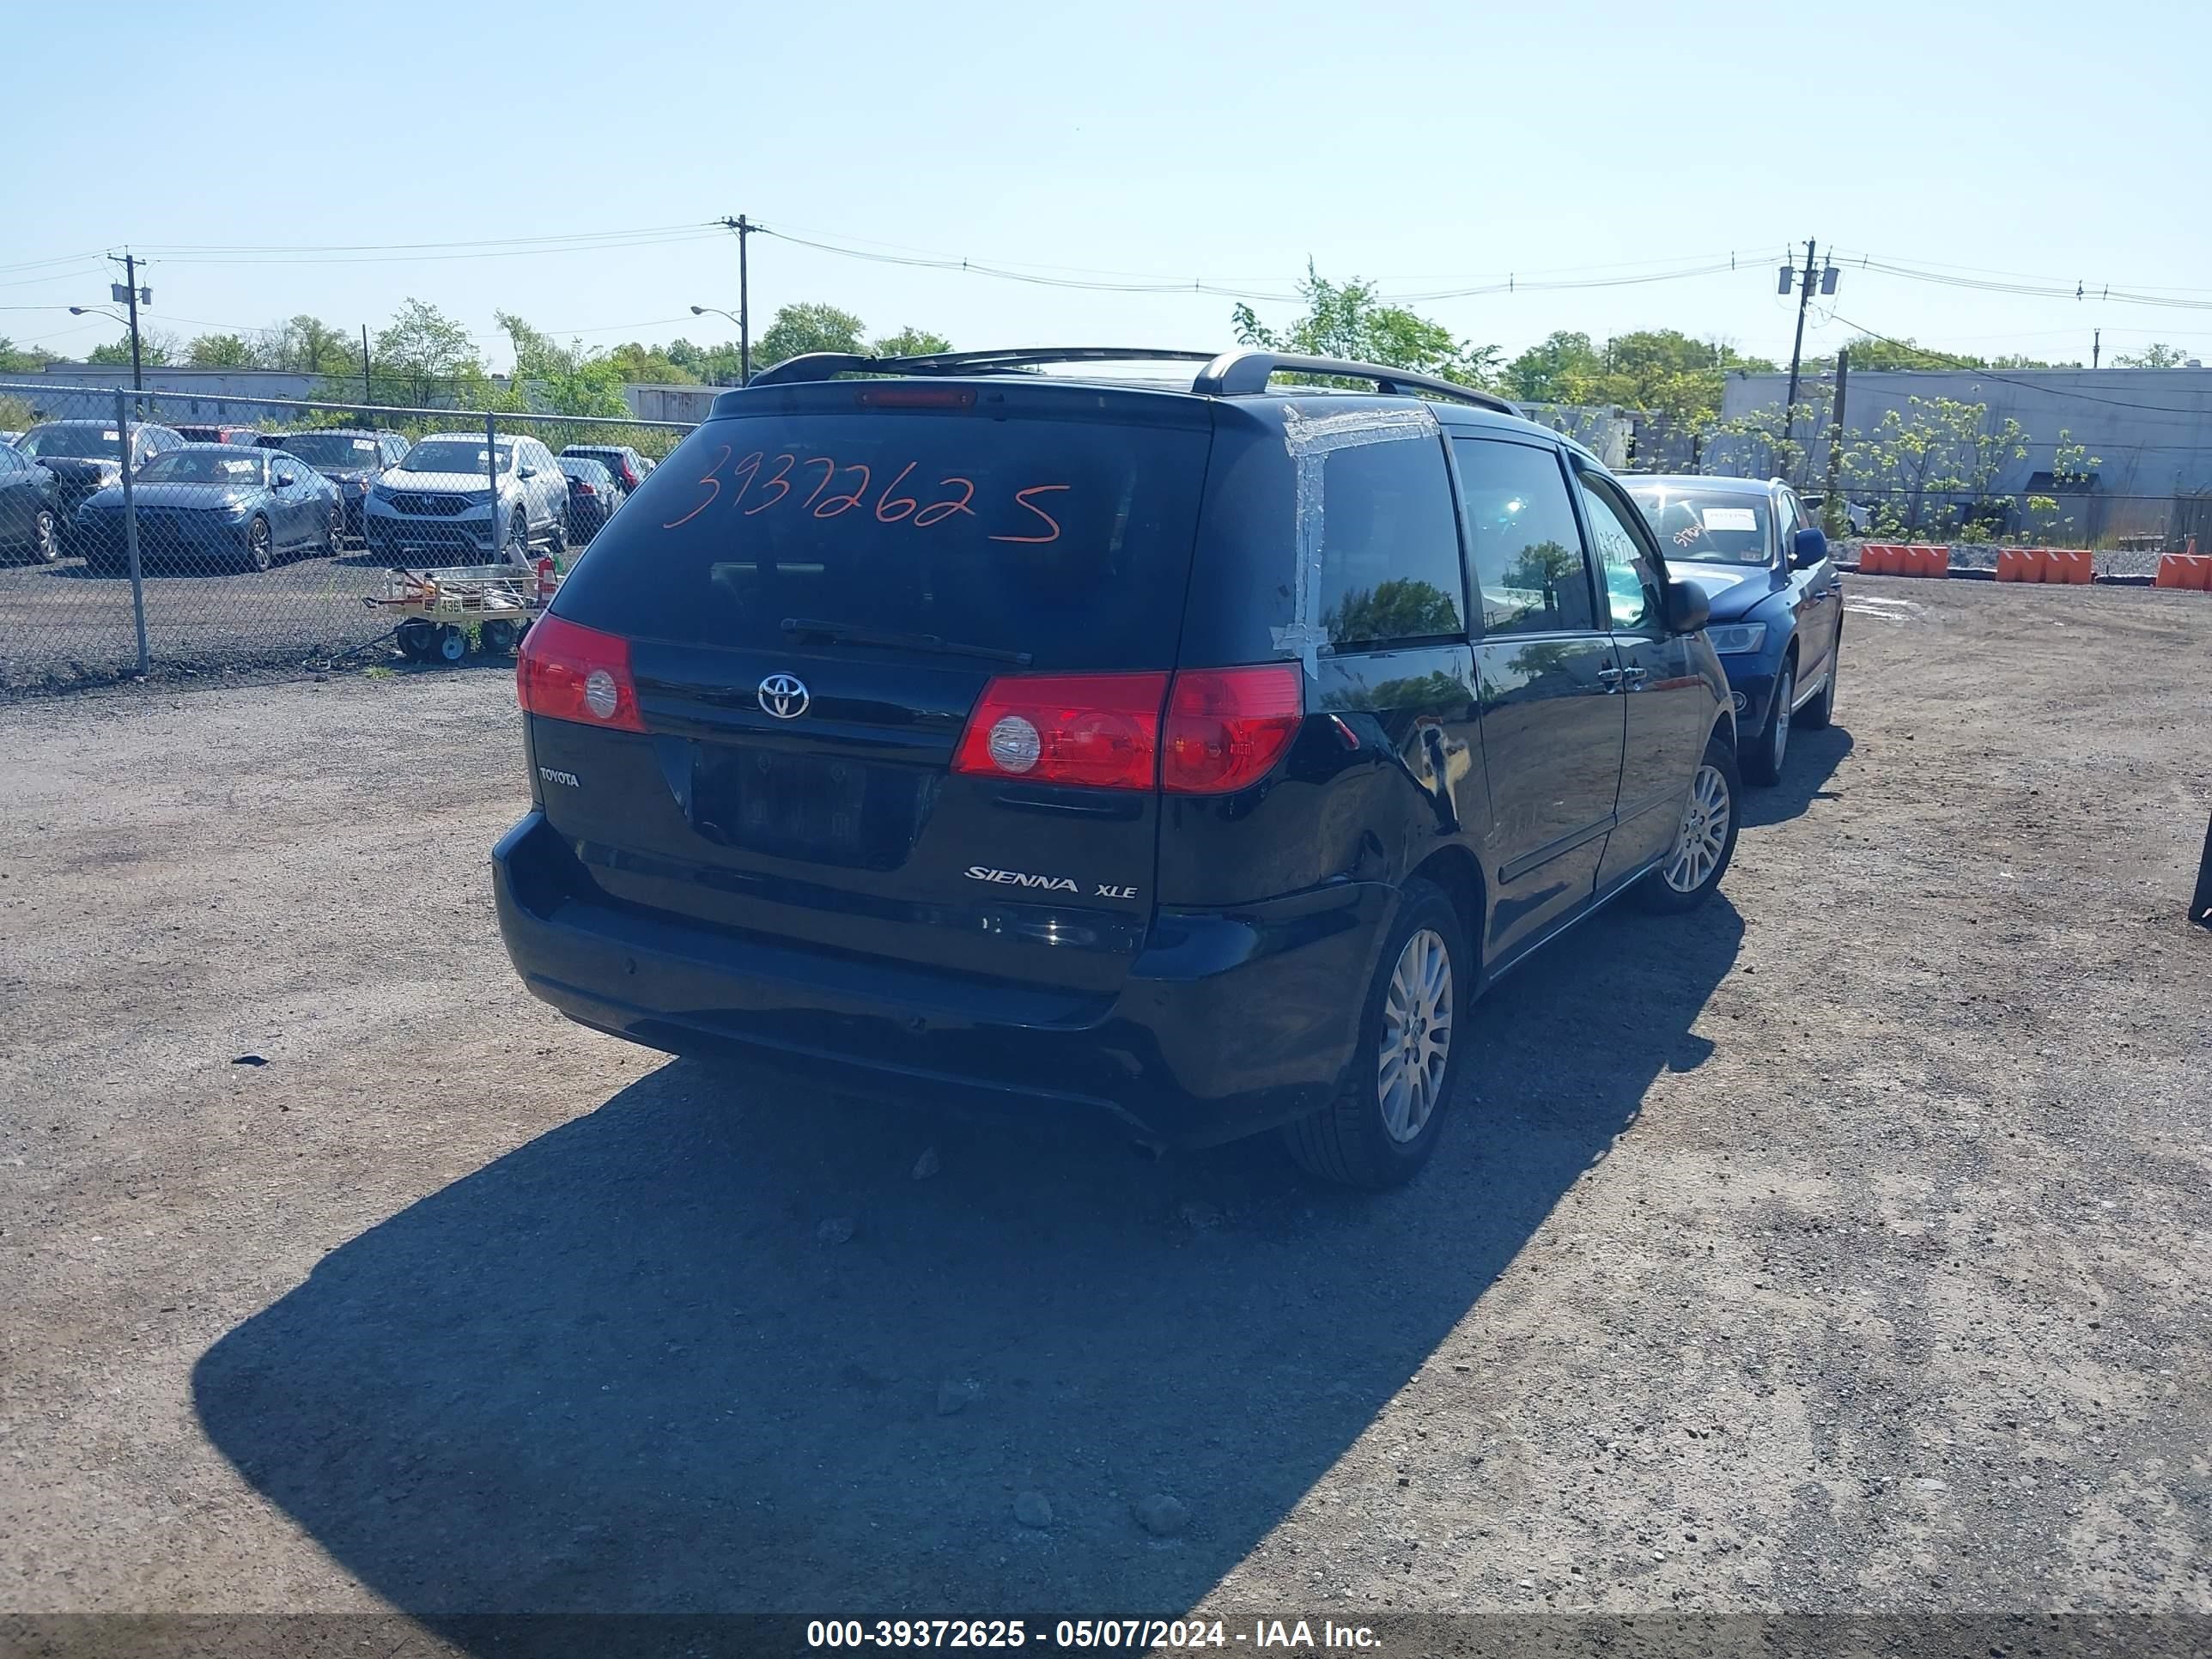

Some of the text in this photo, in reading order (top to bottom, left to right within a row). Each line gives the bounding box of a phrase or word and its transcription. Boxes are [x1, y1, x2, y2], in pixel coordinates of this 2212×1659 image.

[539, 767, 580, 787] TOYOTA
[964, 866, 1138, 899] SIENNA XLE
